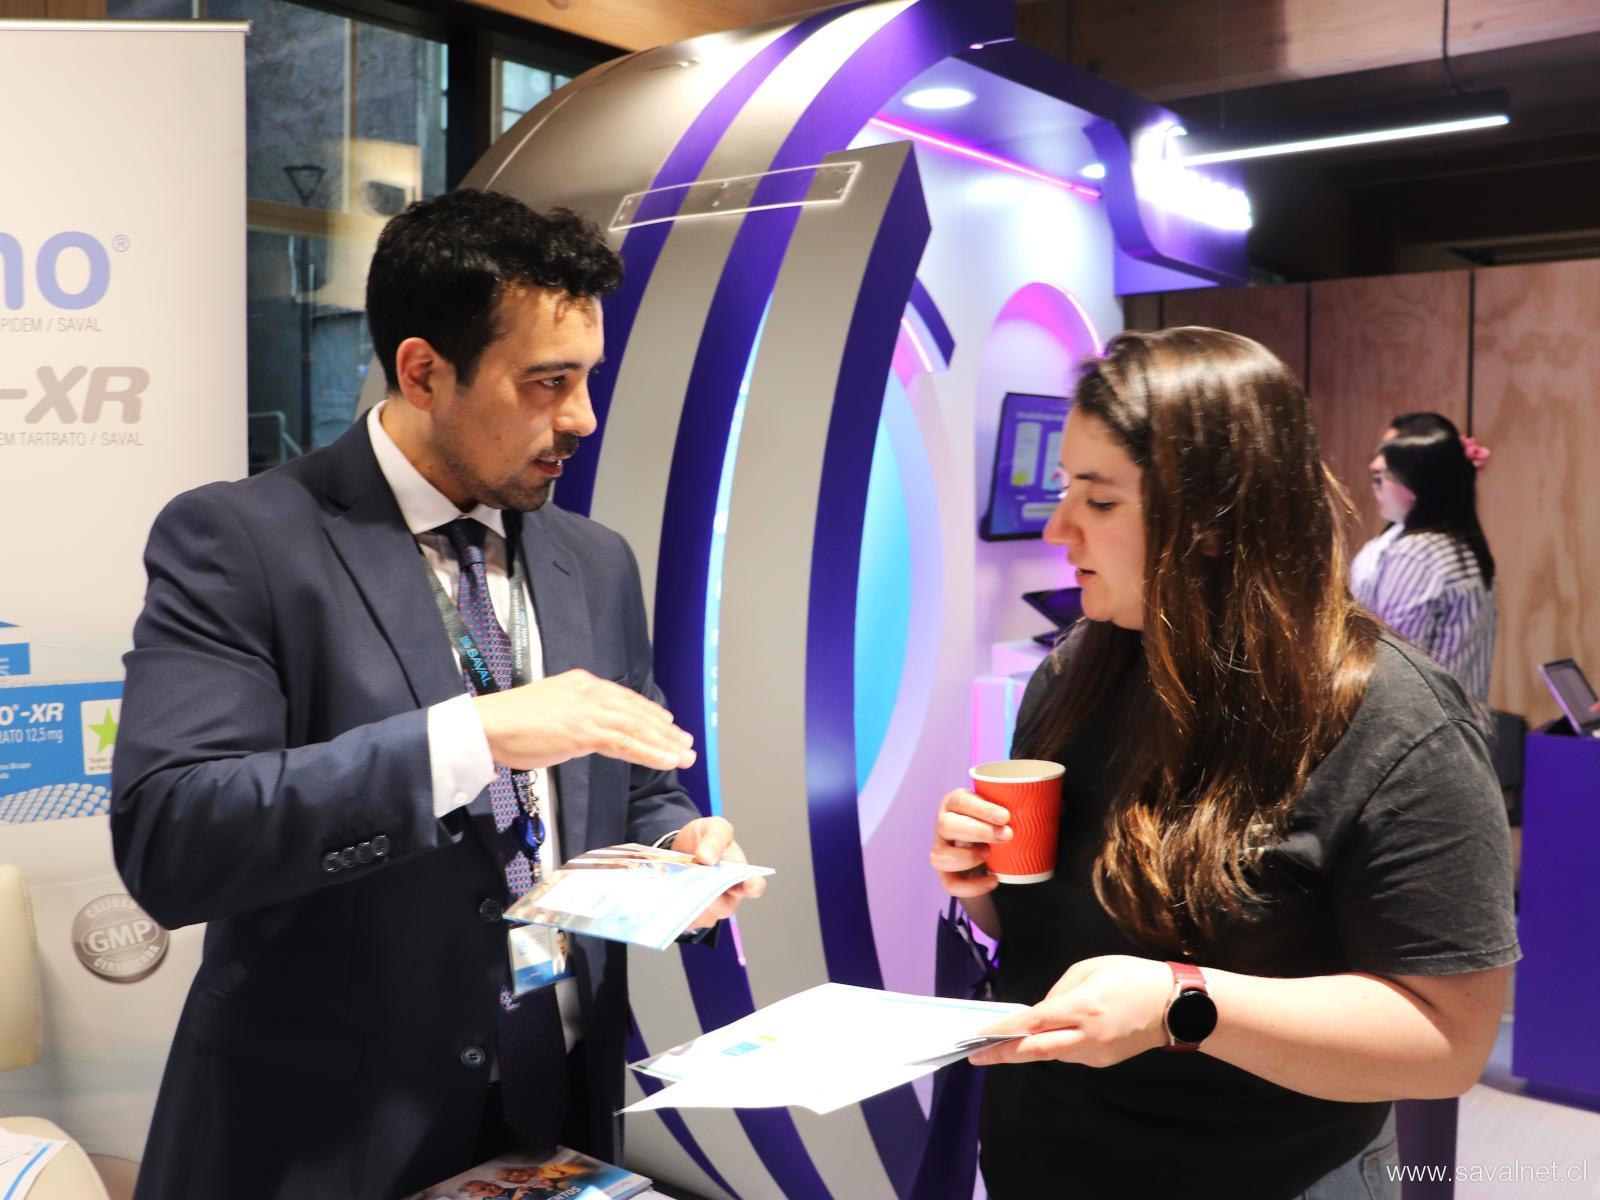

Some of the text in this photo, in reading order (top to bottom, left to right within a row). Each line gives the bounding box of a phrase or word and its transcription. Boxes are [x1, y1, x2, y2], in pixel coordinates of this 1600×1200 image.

[57, 317, 104, 332] SAVAL
[20, 432, 87, 446] TARTRATO
[100, 432, 144, 446] SAVAL
[47, 729, 63, 743] mg
[88, 920, 152, 952] GMP
